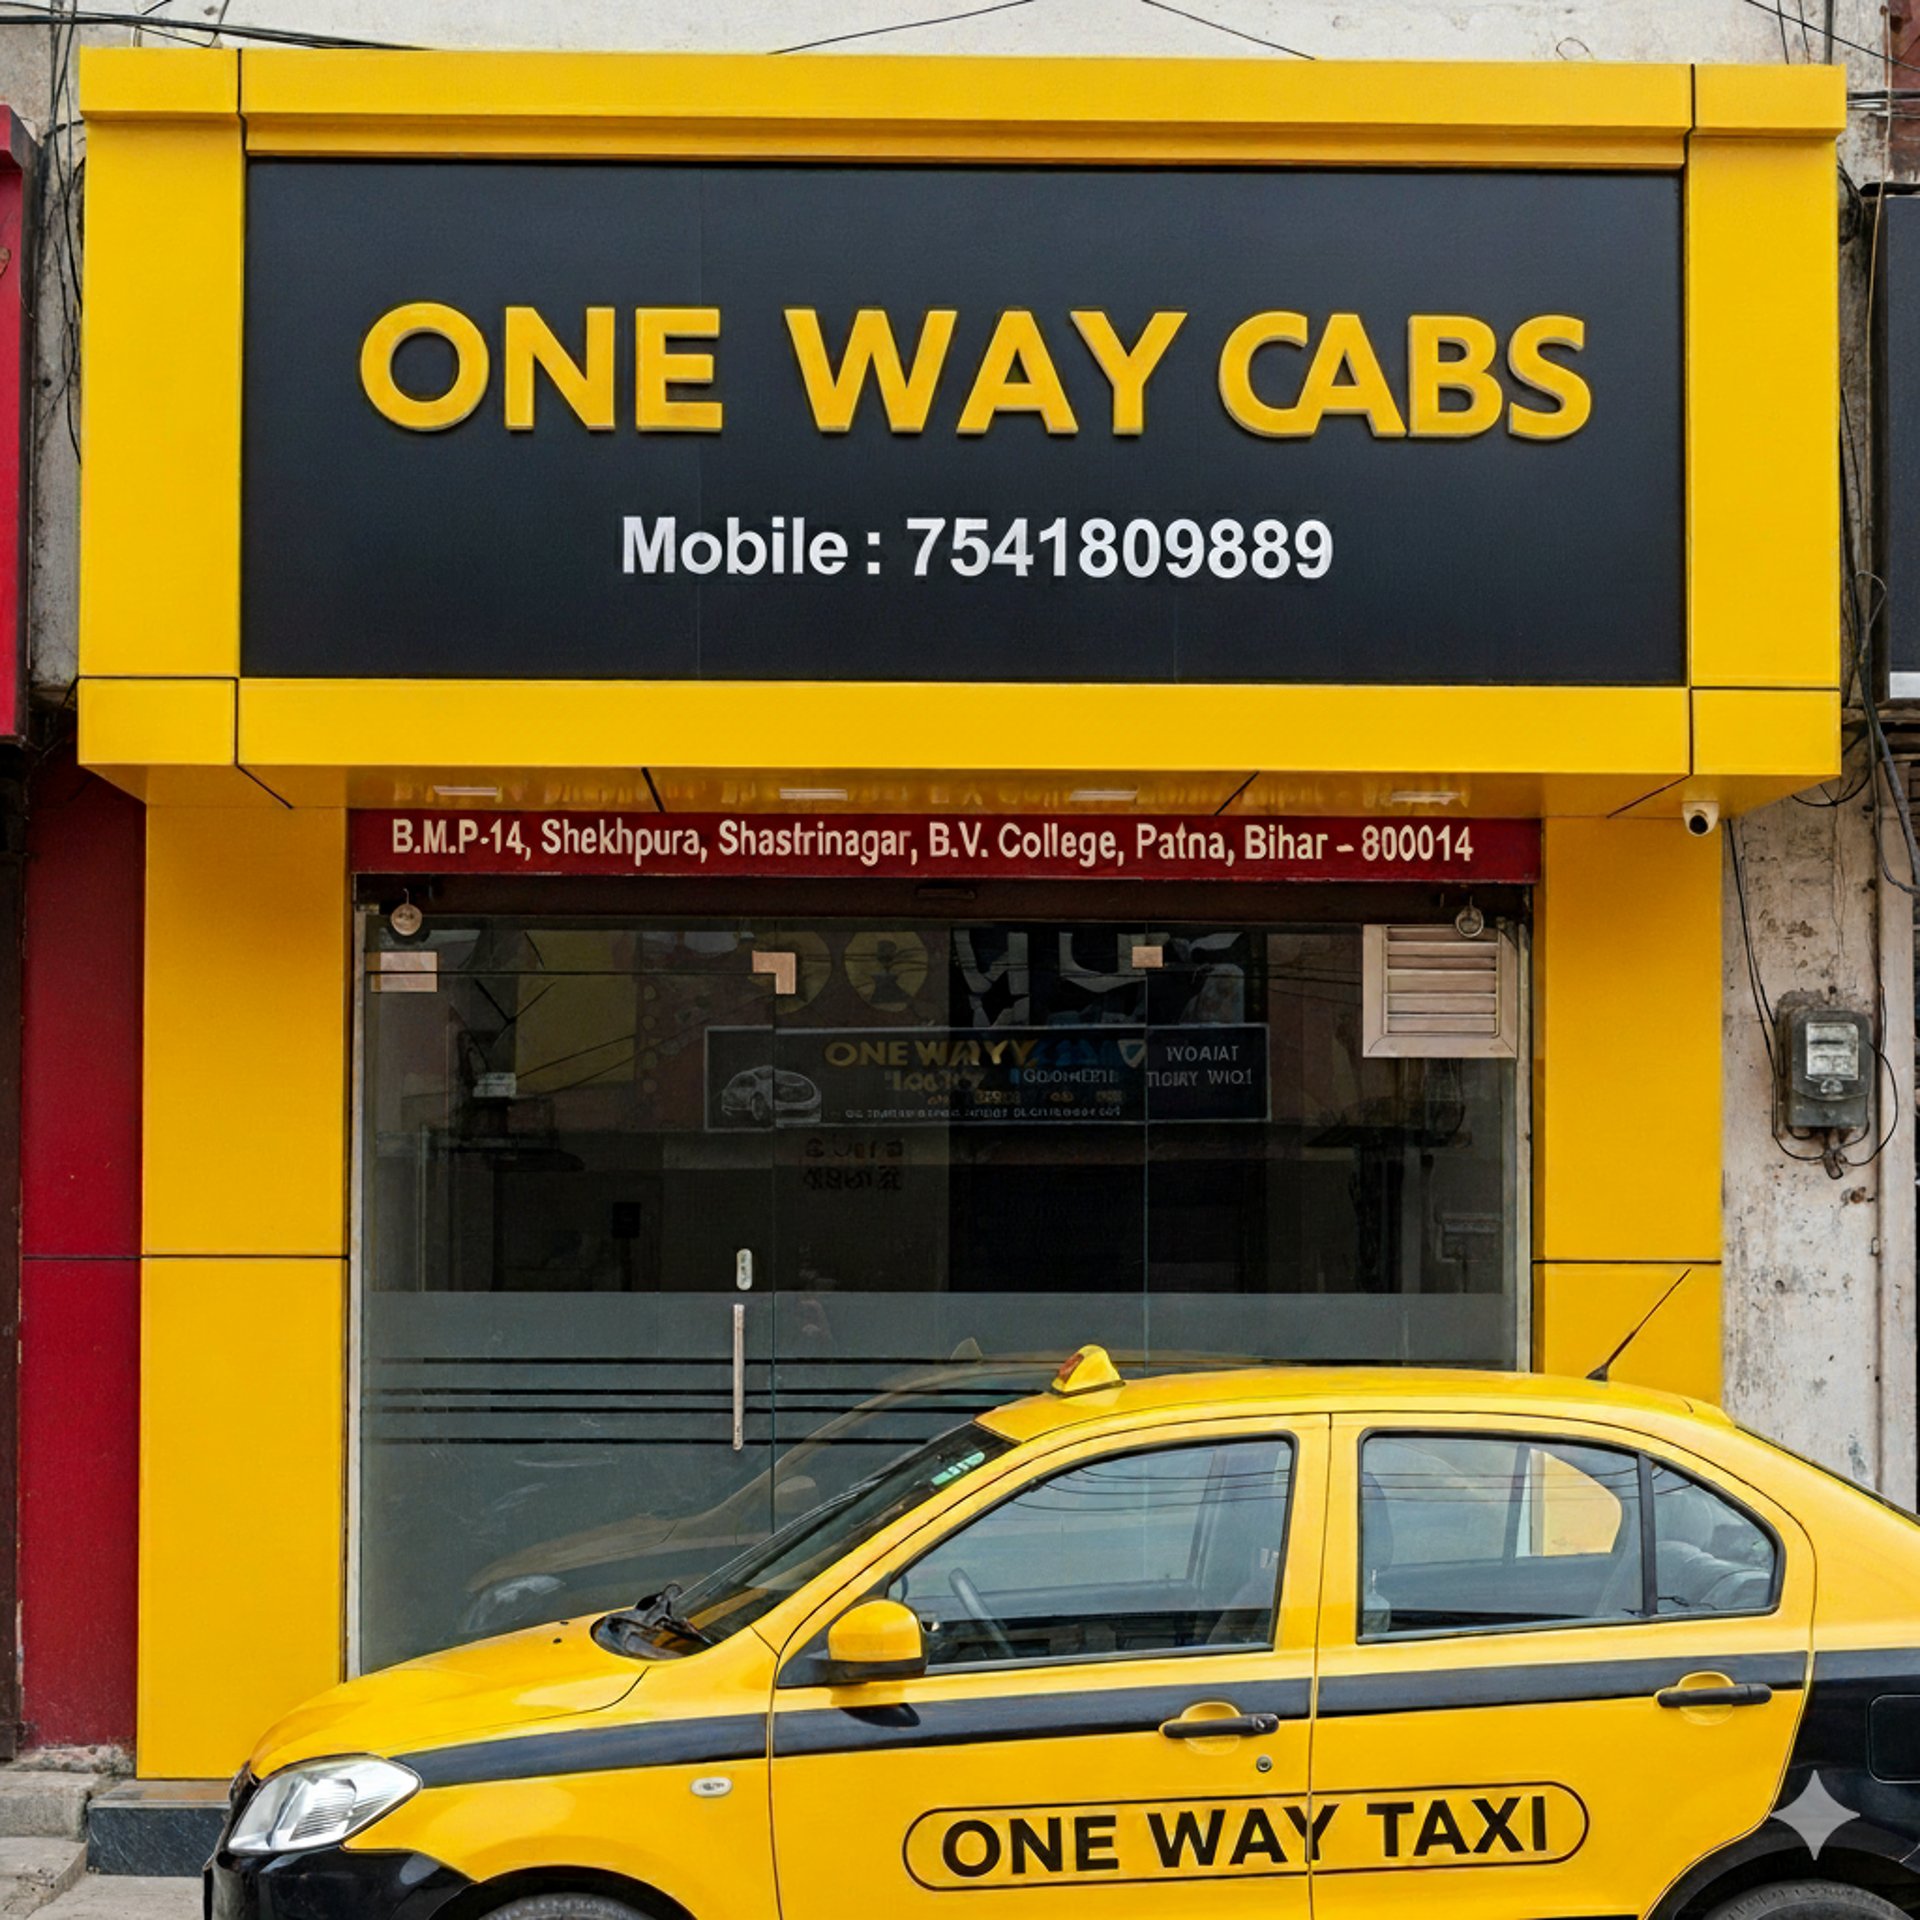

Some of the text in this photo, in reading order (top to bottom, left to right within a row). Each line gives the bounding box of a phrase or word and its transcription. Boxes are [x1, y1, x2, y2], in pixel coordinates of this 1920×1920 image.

[361, 303, 1591, 438] ONE WAY CABS
[624, 517, 848, 574] Mobile
[907, 518, 1332, 578] 7541809889
[394, 819, 531, 860] B.M.P-14,
[542, 818, 707, 866] Shekhpura,
[719, 820, 917, 866] Shastrinagar,
[930, 822, 988, 857] B.V.
[999, 823, 1123, 866] College,
[1138, 824, 1234, 866] Patna,
[1246, 825, 1328, 859] Bihar
[1362, 825, 1473, 861] 800014
[824, 1041, 908, 1067] ONE
[942, 1795, 1548, 1877] ONE WAY TAXI
